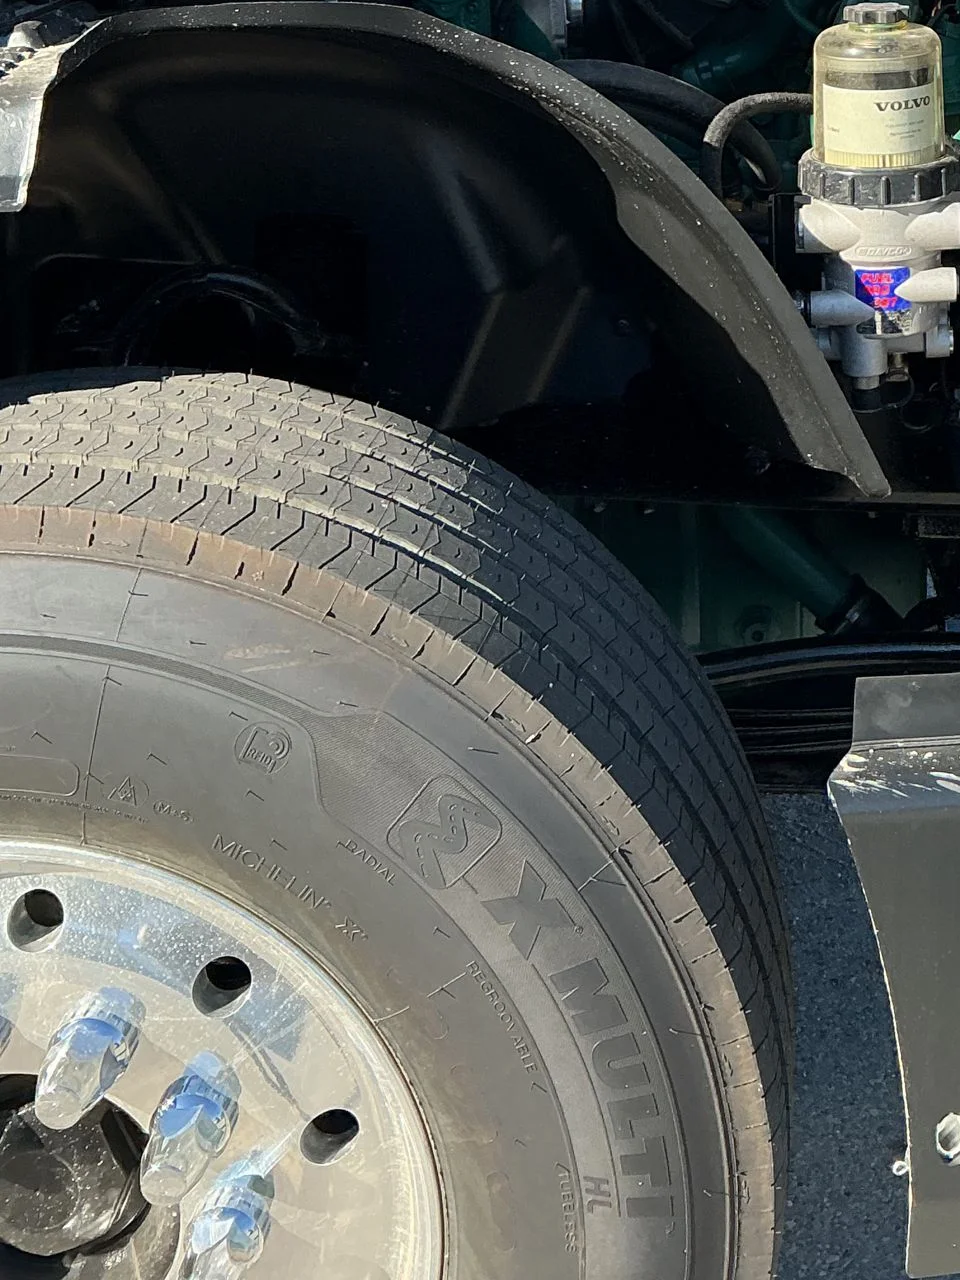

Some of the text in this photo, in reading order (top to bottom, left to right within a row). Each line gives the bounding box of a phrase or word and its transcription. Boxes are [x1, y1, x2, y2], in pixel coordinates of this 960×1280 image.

[874, 95, 930, 112] VOLVO
[247, 746, 274, 770] RFID
[210, 831, 326, 911] MICHELIN
[344, 839, 396, 886] RADIAL
[481, 858, 675, 1220] X MULTI
[558, 1171, 578, 1253] TUBELESS
[582, 1174, 613, 1215] HL
